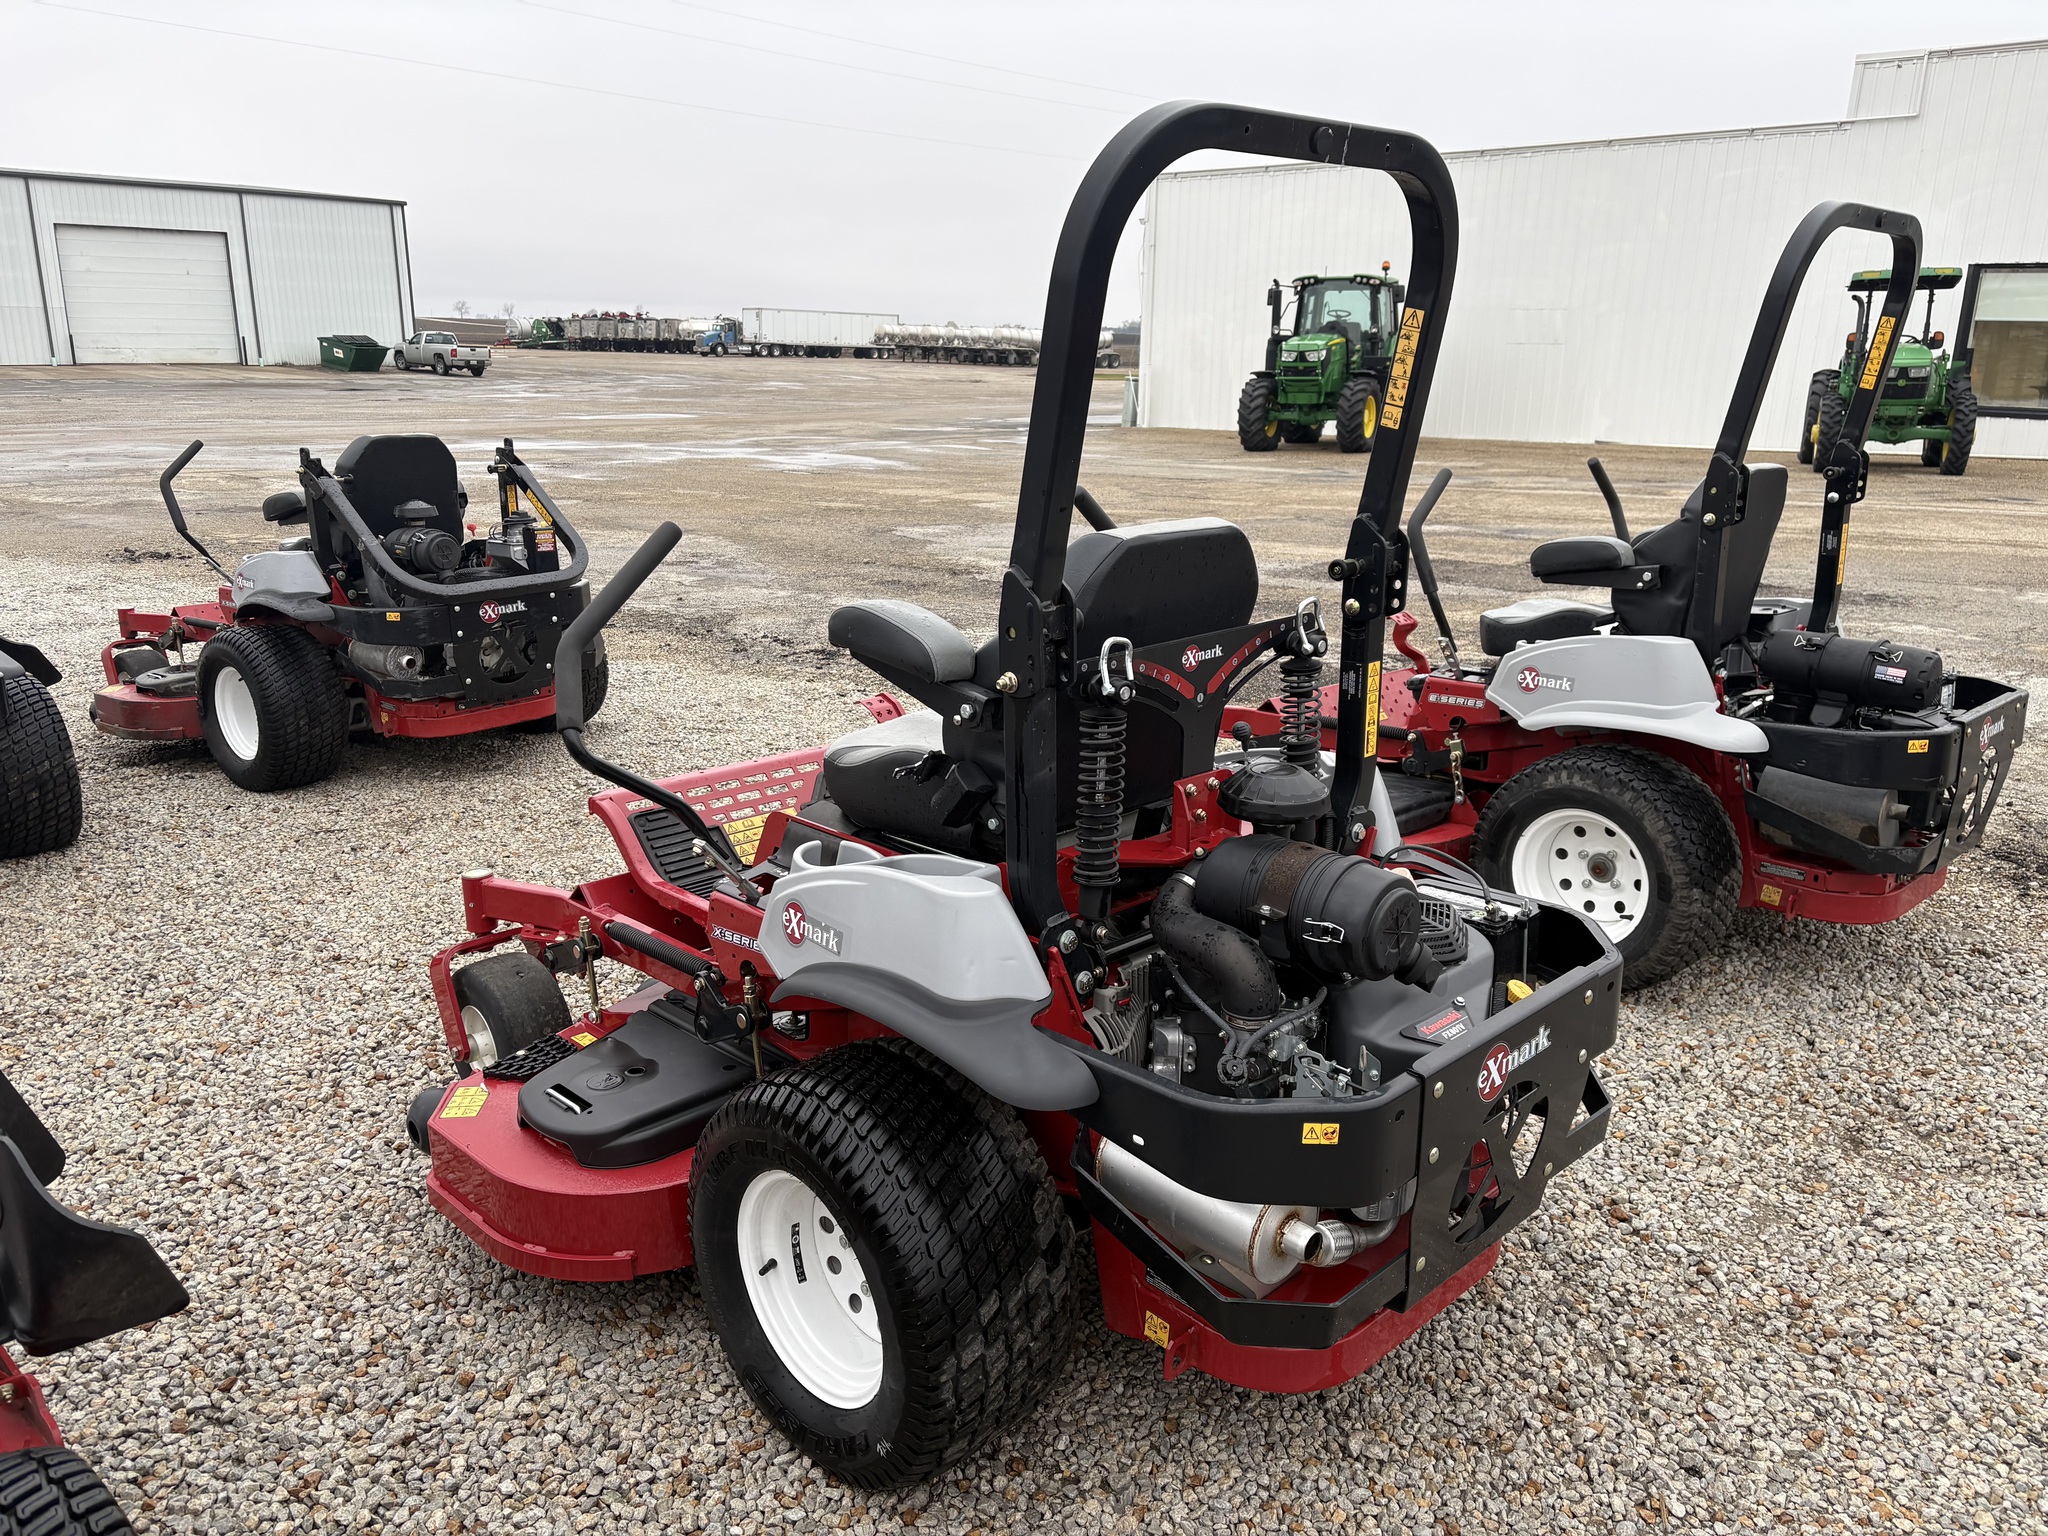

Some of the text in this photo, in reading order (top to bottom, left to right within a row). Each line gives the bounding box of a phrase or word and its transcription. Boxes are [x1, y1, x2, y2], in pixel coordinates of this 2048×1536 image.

[479, 600, 527, 620] eXmark
[1181, 643, 1224, 669] eXmark
[1517, 670, 1573, 692] eXmark
[711, 925, 761, 952] X-SERIE
[782, 907, 840, 953] eXmark
[1420, 1010, 1462, 1035] Kawasaki
[1477, 1023, 1552, 1095] eXmark
